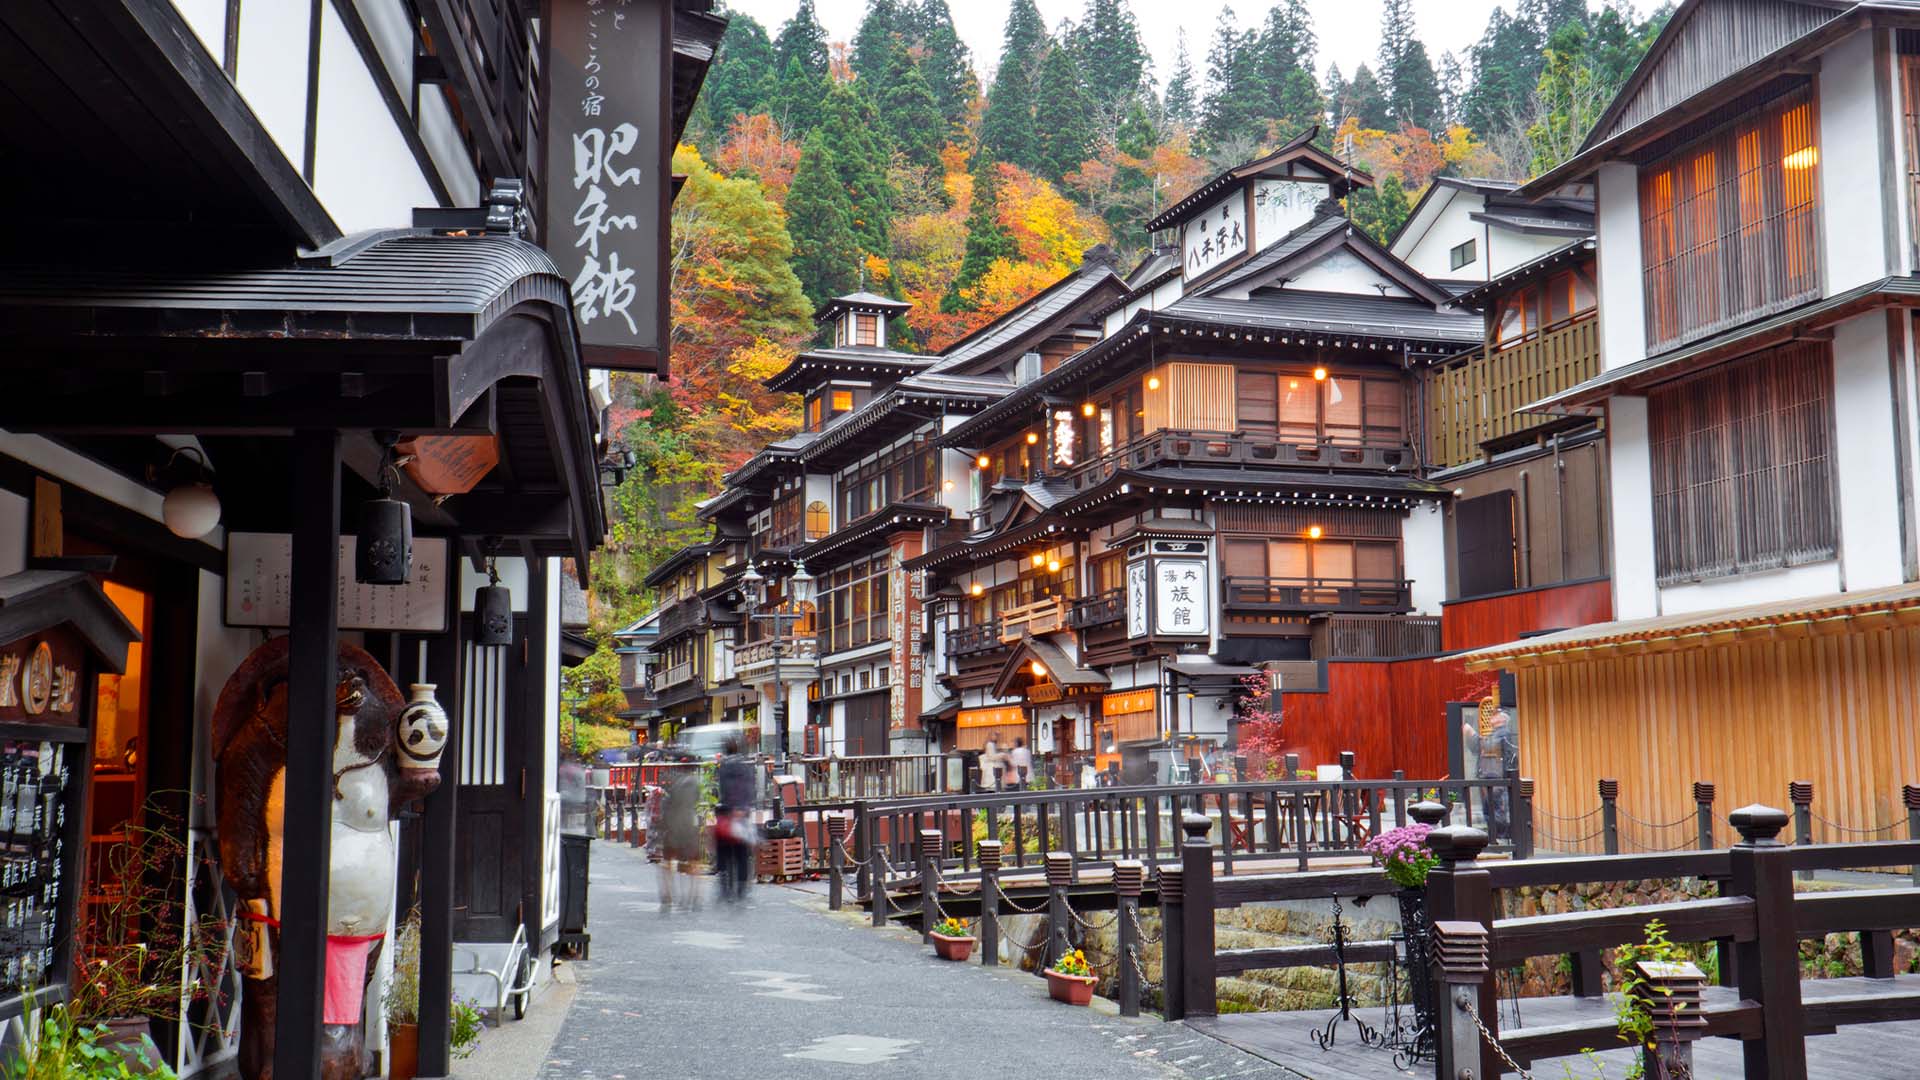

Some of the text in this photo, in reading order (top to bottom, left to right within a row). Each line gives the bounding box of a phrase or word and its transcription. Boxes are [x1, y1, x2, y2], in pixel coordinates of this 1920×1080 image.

[570, 122, 642, 336] 昭和館
[1170, 585, 1195, 627] 旅館
